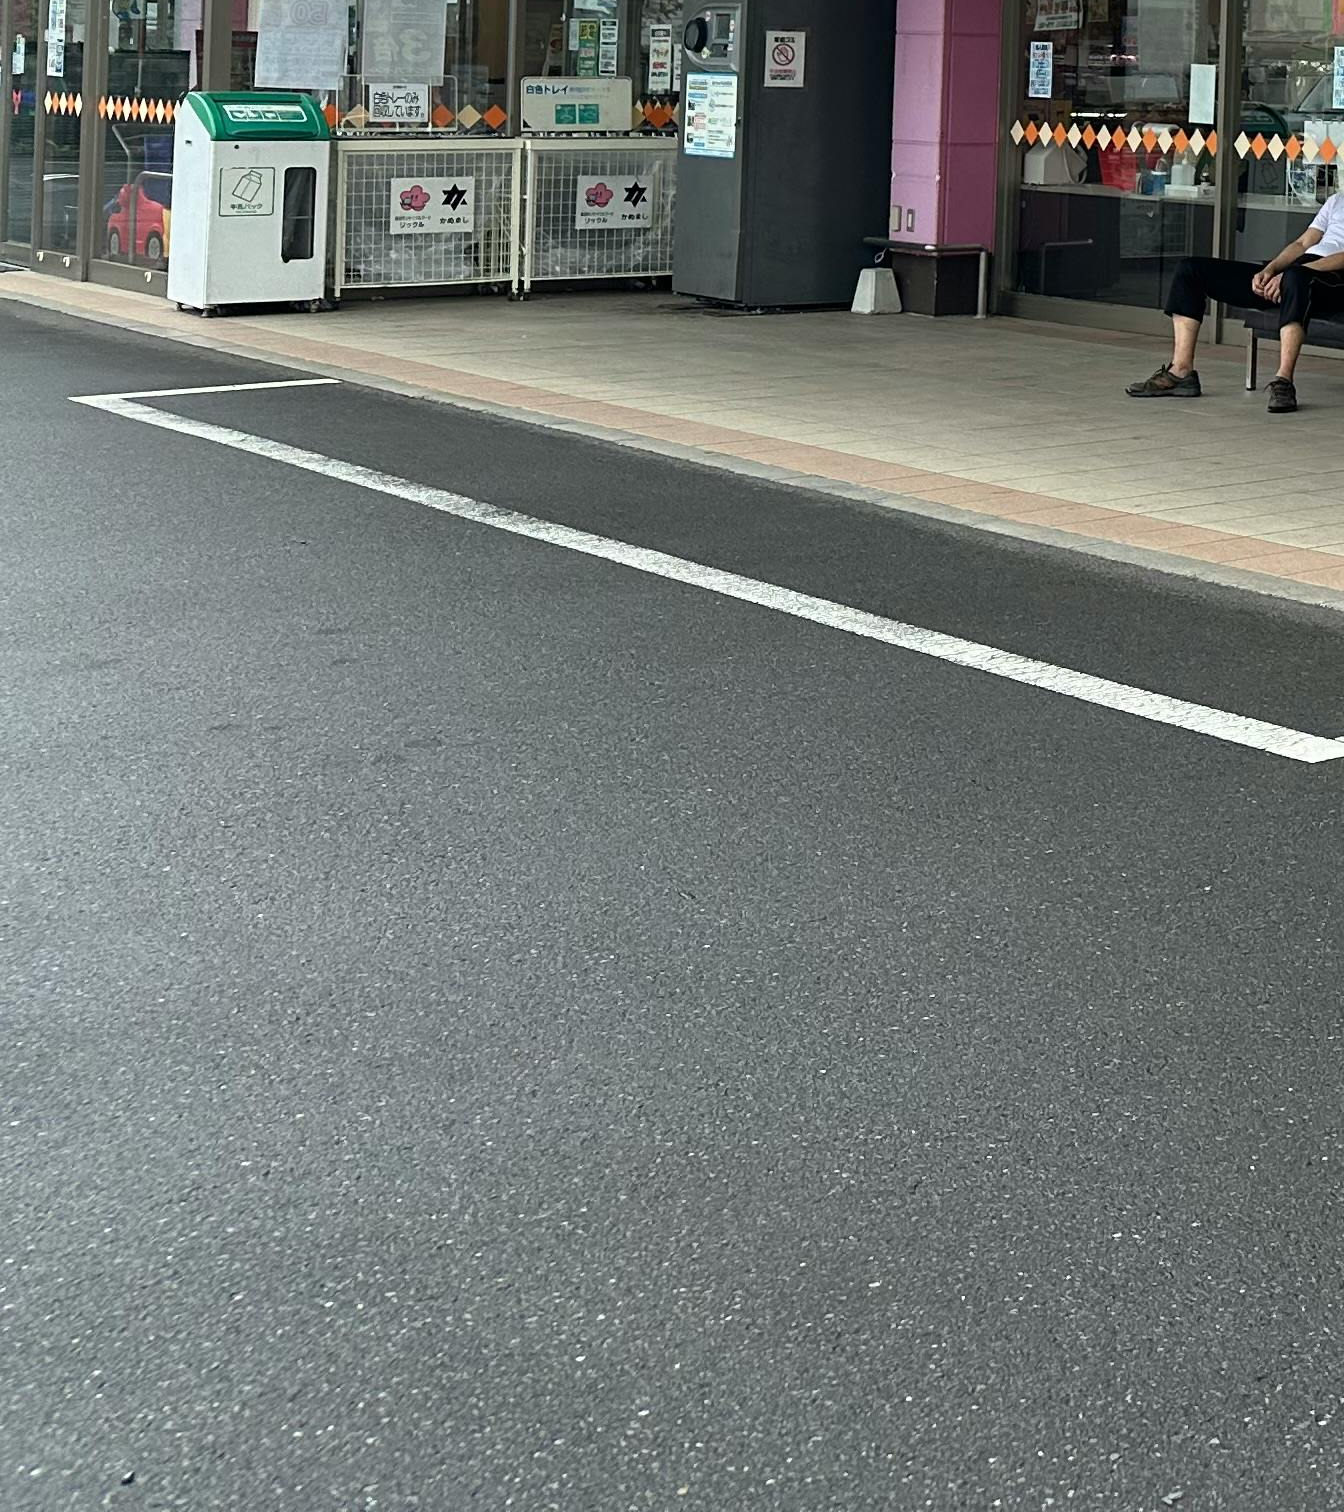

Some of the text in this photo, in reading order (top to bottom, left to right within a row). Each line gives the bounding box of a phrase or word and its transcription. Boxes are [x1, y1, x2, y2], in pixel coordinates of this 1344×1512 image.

[526, 84, 569, 95] 白色トレイ
